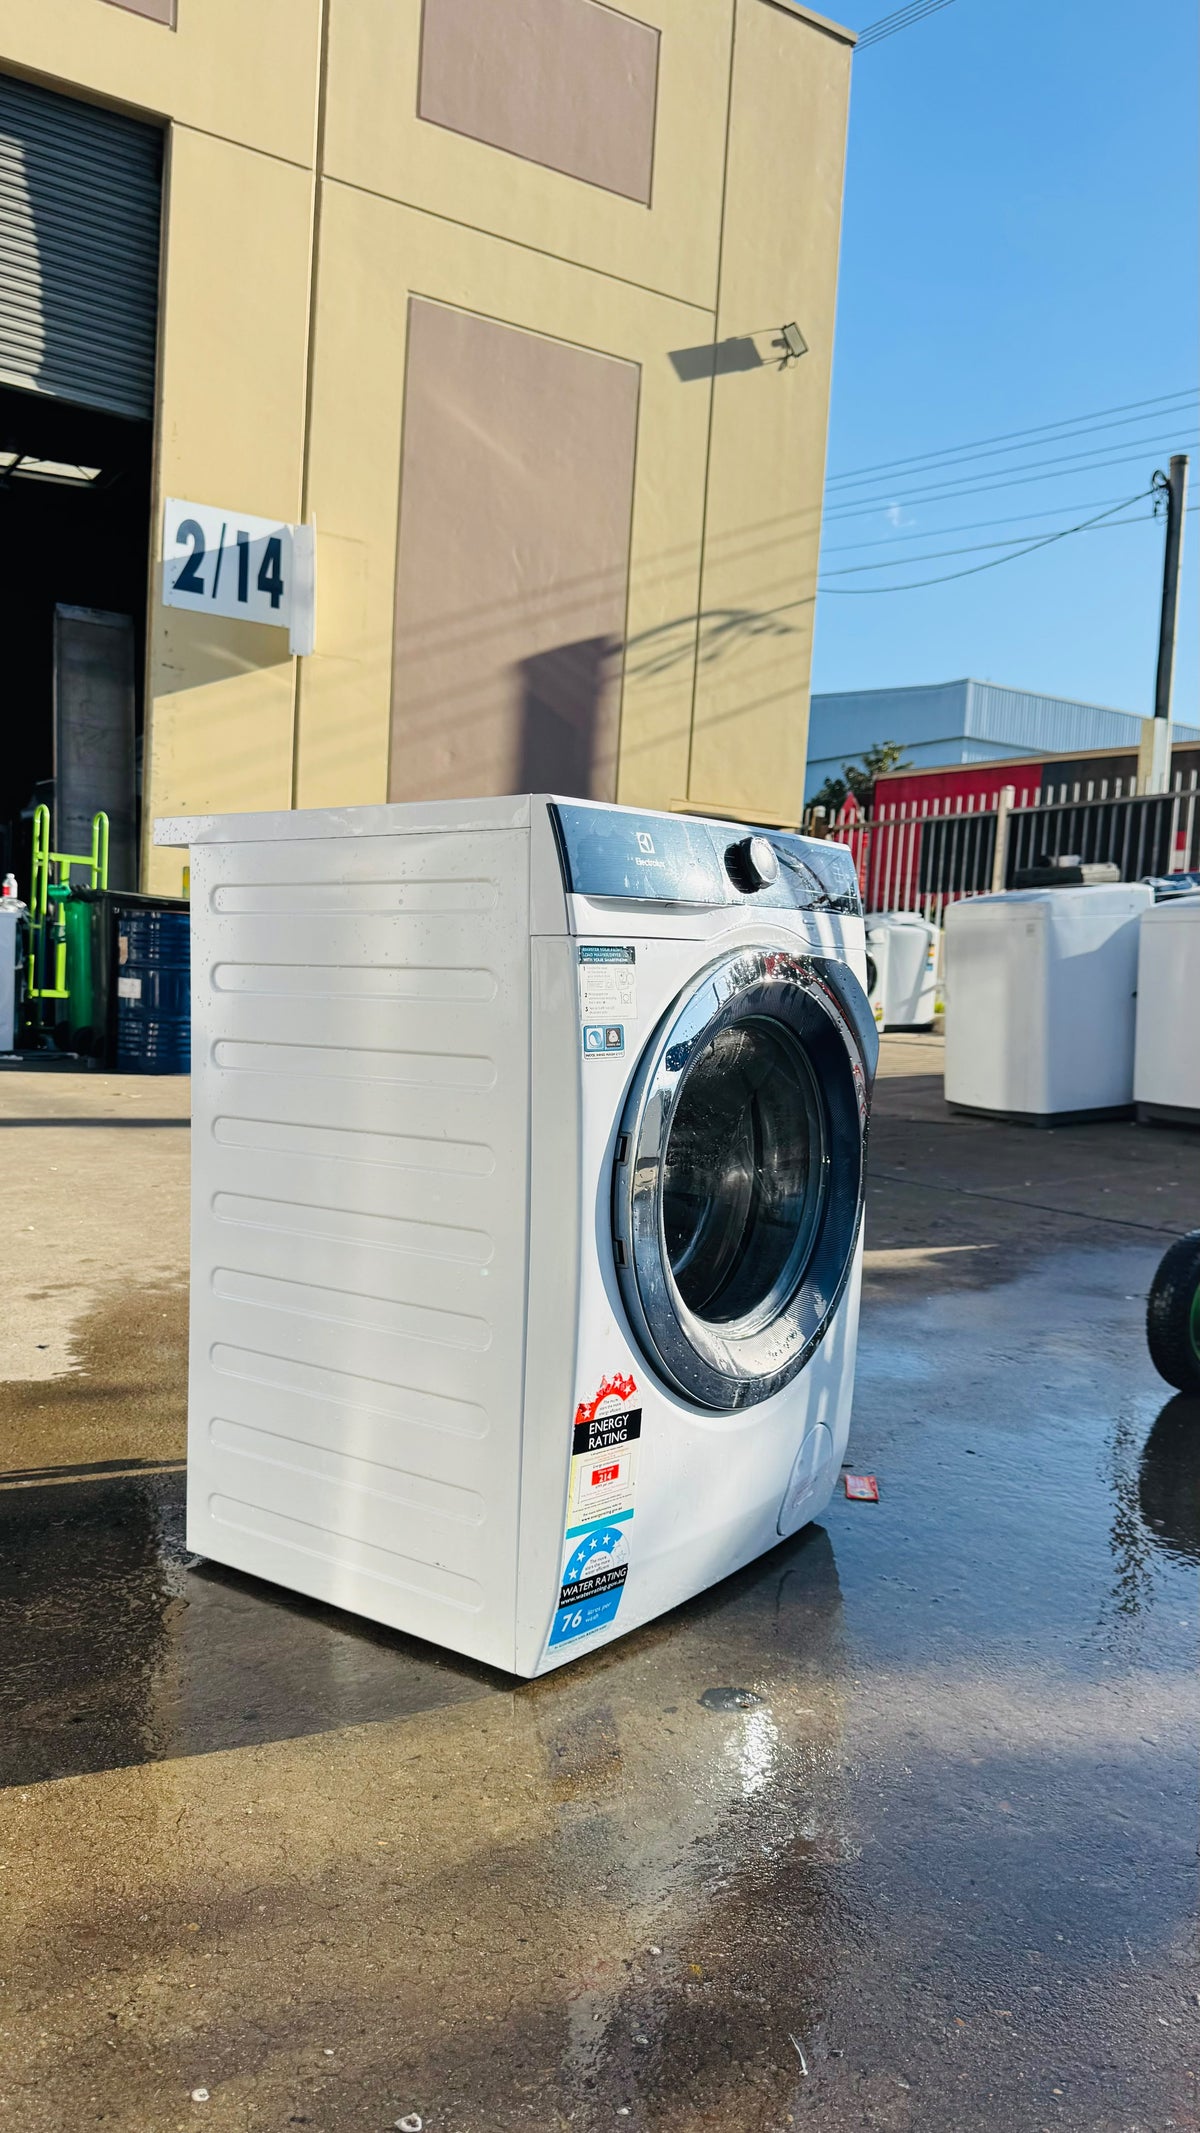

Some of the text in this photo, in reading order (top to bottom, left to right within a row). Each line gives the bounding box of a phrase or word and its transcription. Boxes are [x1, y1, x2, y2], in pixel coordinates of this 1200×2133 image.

[173, 518, 283, 609] 2/14
[635, 857, 666, 869] Electrolux
[589, 1413, 629, 1435] ENERGY
[588, 1429, 628, 1450] RATING
[598, 1472, 612, 1483] 214
[560, 1578, 625, 1605] www.waterrating.gov.au
[562, 1567, 627, 1598] WATER RATING
[601, 1601, 612, 1612] per
[561, 1608, 583, 1632] 76
